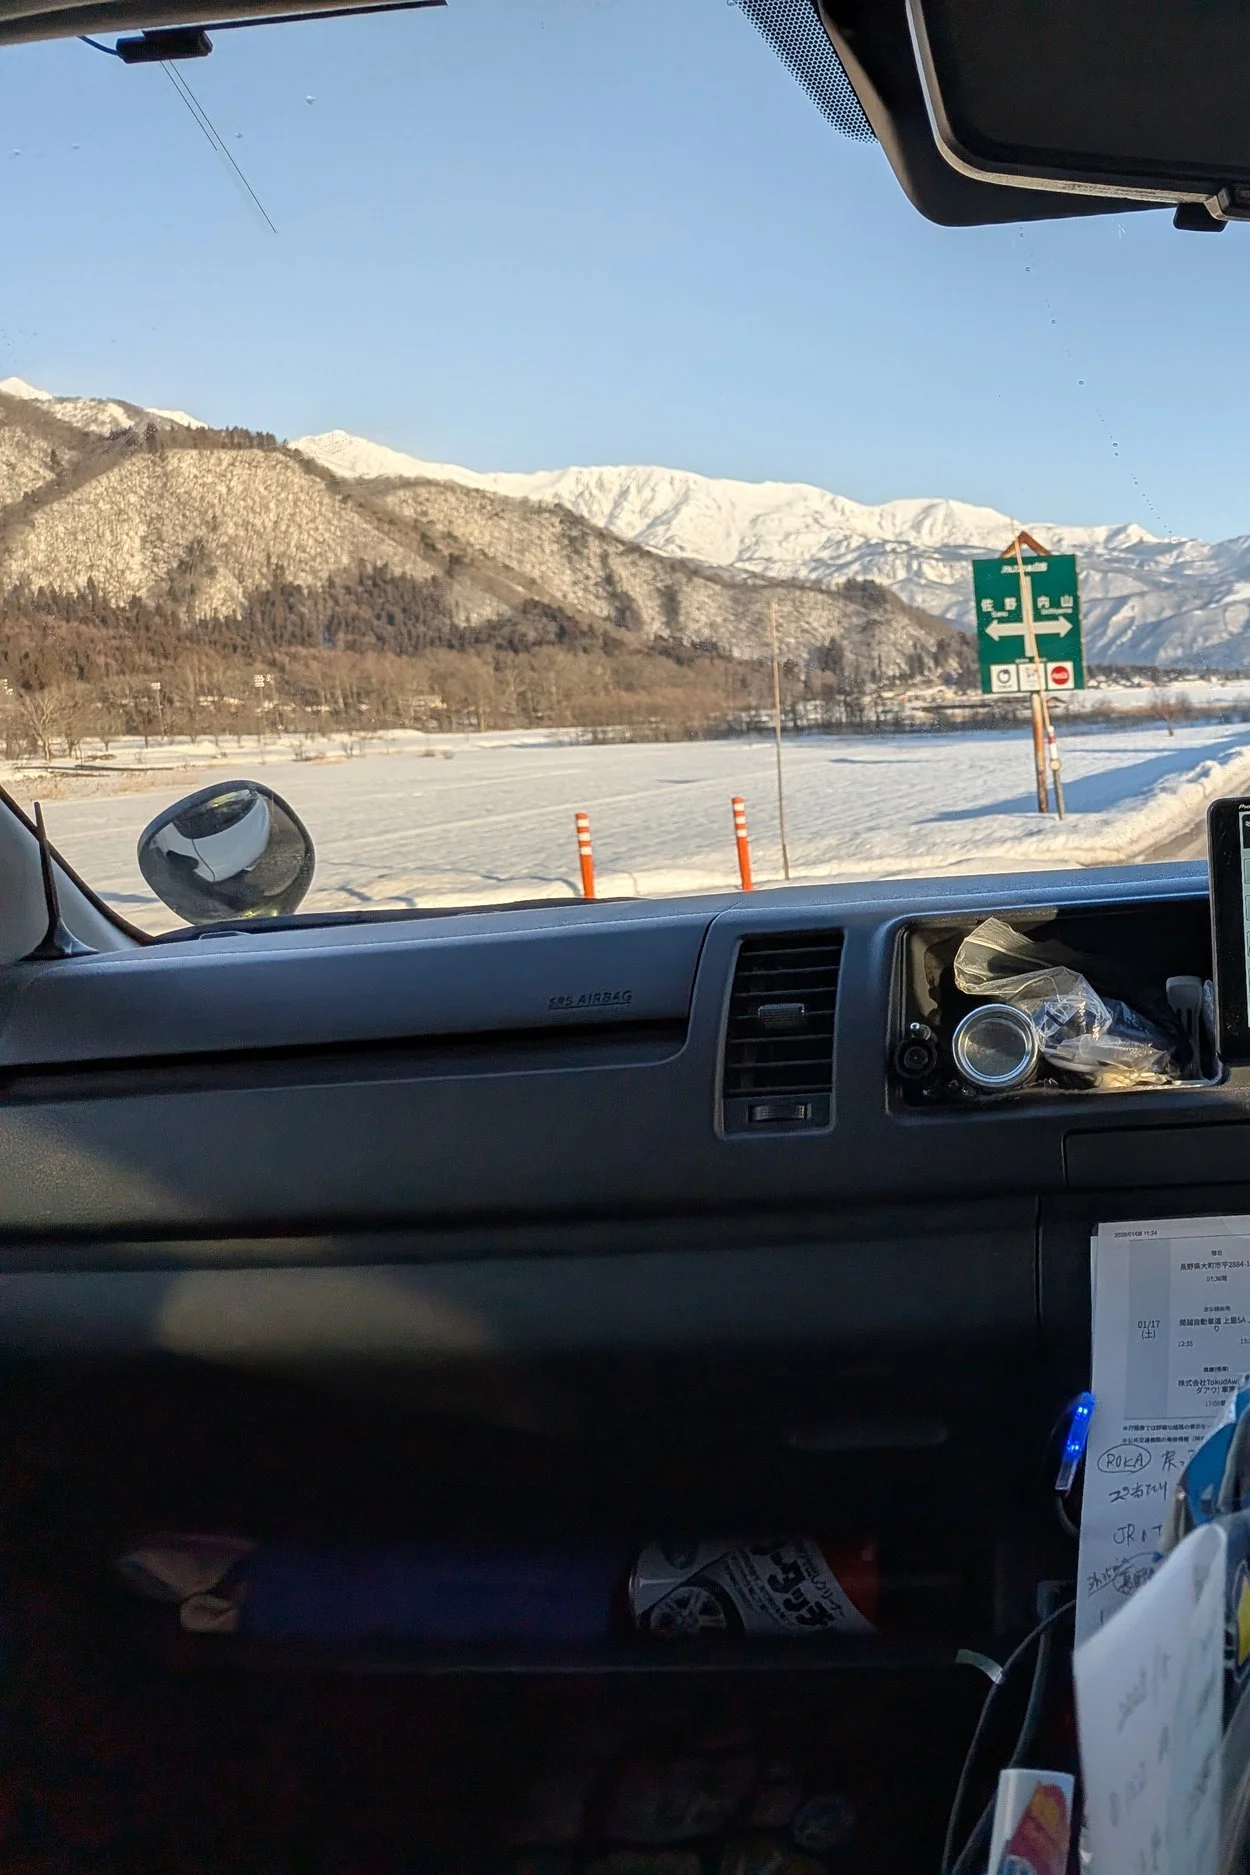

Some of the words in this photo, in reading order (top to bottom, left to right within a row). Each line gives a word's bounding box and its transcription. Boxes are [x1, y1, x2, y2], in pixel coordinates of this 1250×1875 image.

[1138, 1320, 1160, 1330] 01/17
[1142, 1329, 1156, 1340] (土)
[1106, 1453, 1144, 1468] ROKA
